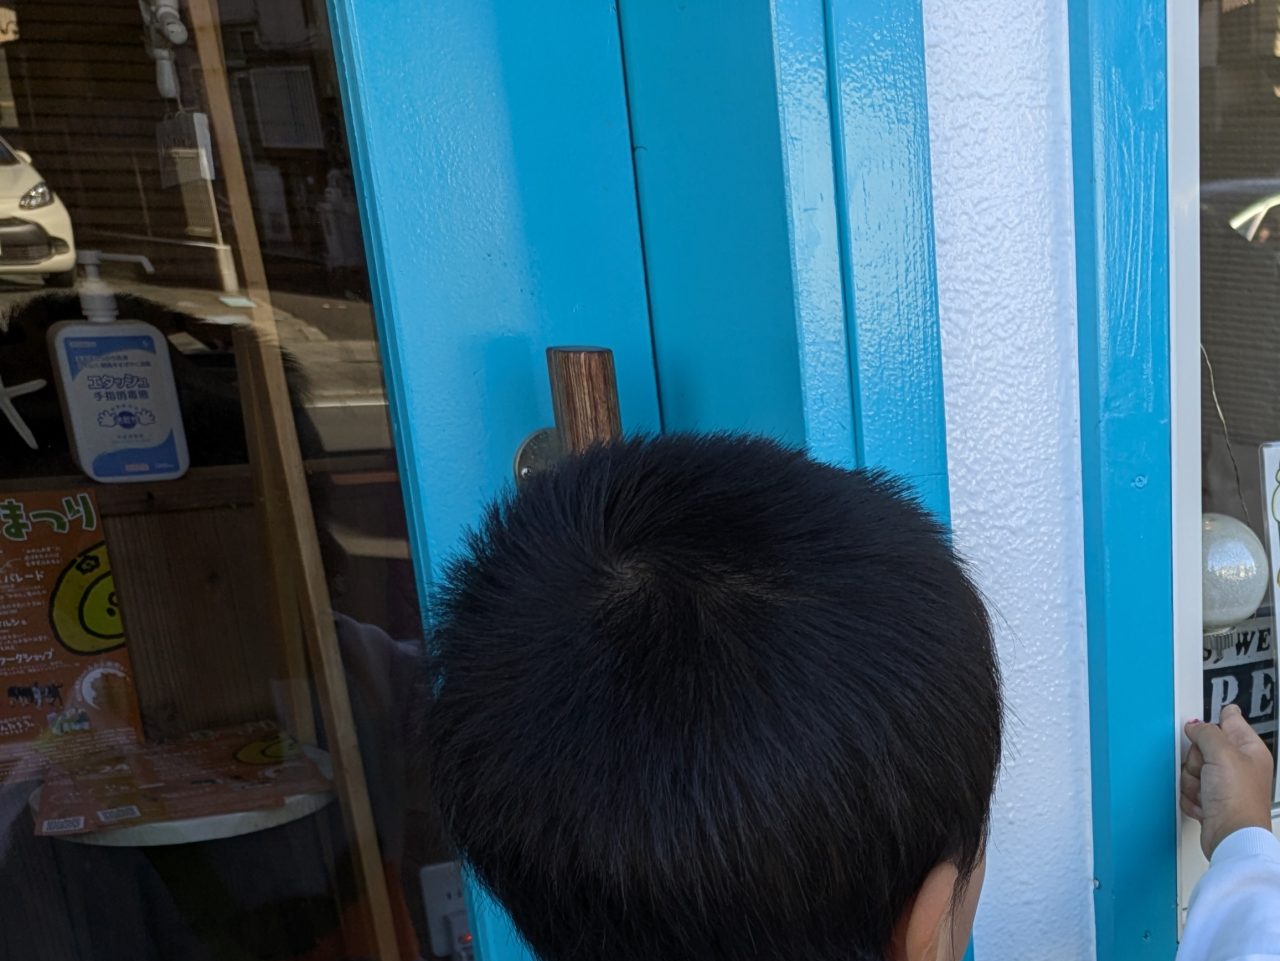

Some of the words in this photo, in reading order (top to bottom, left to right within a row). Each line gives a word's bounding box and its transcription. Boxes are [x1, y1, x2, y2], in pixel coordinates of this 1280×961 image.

[87, 374, 150, 390] エタッシュ
[0, 493, 97, 541] まつり
[1235, 628, 1272, 656] WE
